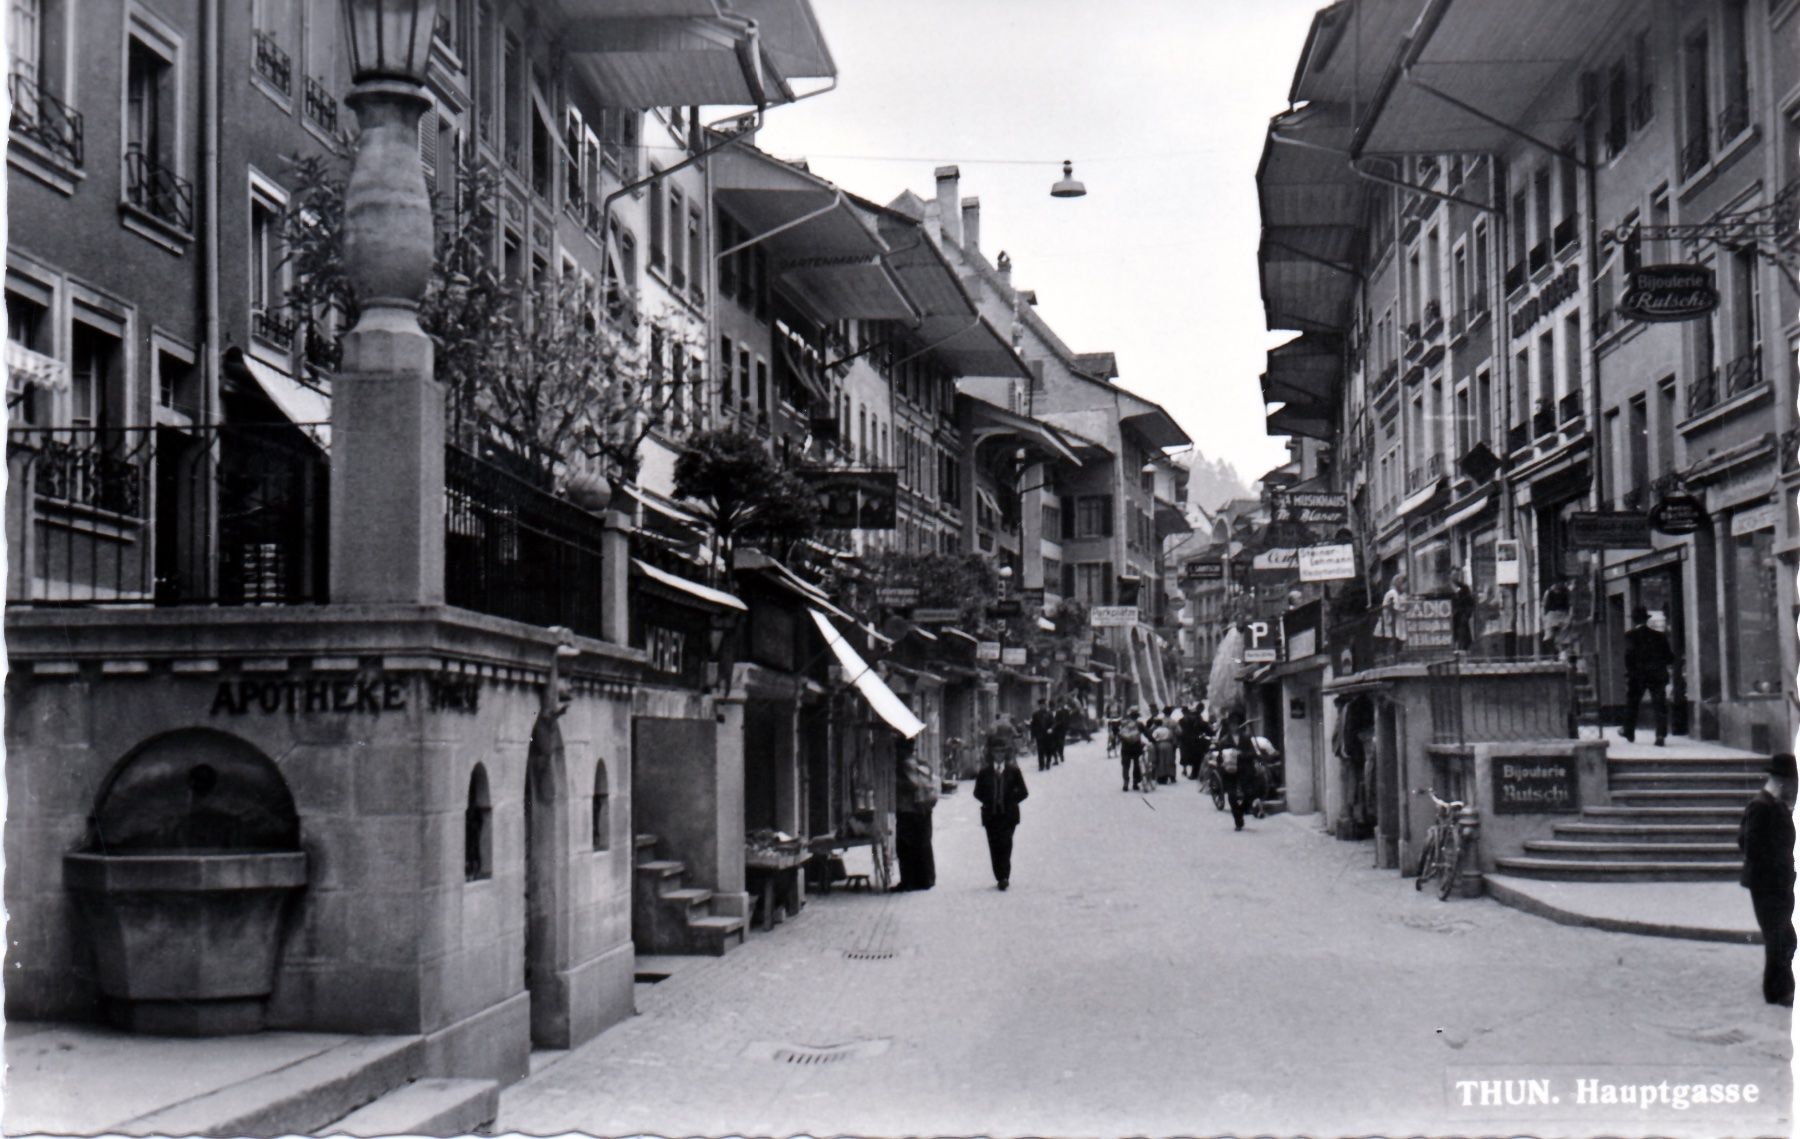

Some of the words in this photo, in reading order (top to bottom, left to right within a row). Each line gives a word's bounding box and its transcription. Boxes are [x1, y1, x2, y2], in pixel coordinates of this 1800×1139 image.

[1637, 273, 1704, 291] Bijouterie
[1293, 494, 1346, 507] MUSIKHAUS
[1407, 600, 1451, 618] ADIO
[1252, 621, 1268, 649] P
[210, 680, 405, 715] APOTHEKE
[1503, 764, 1566, 782] Bijouterie
[1502, 783, 1569, 801] Rutschi
